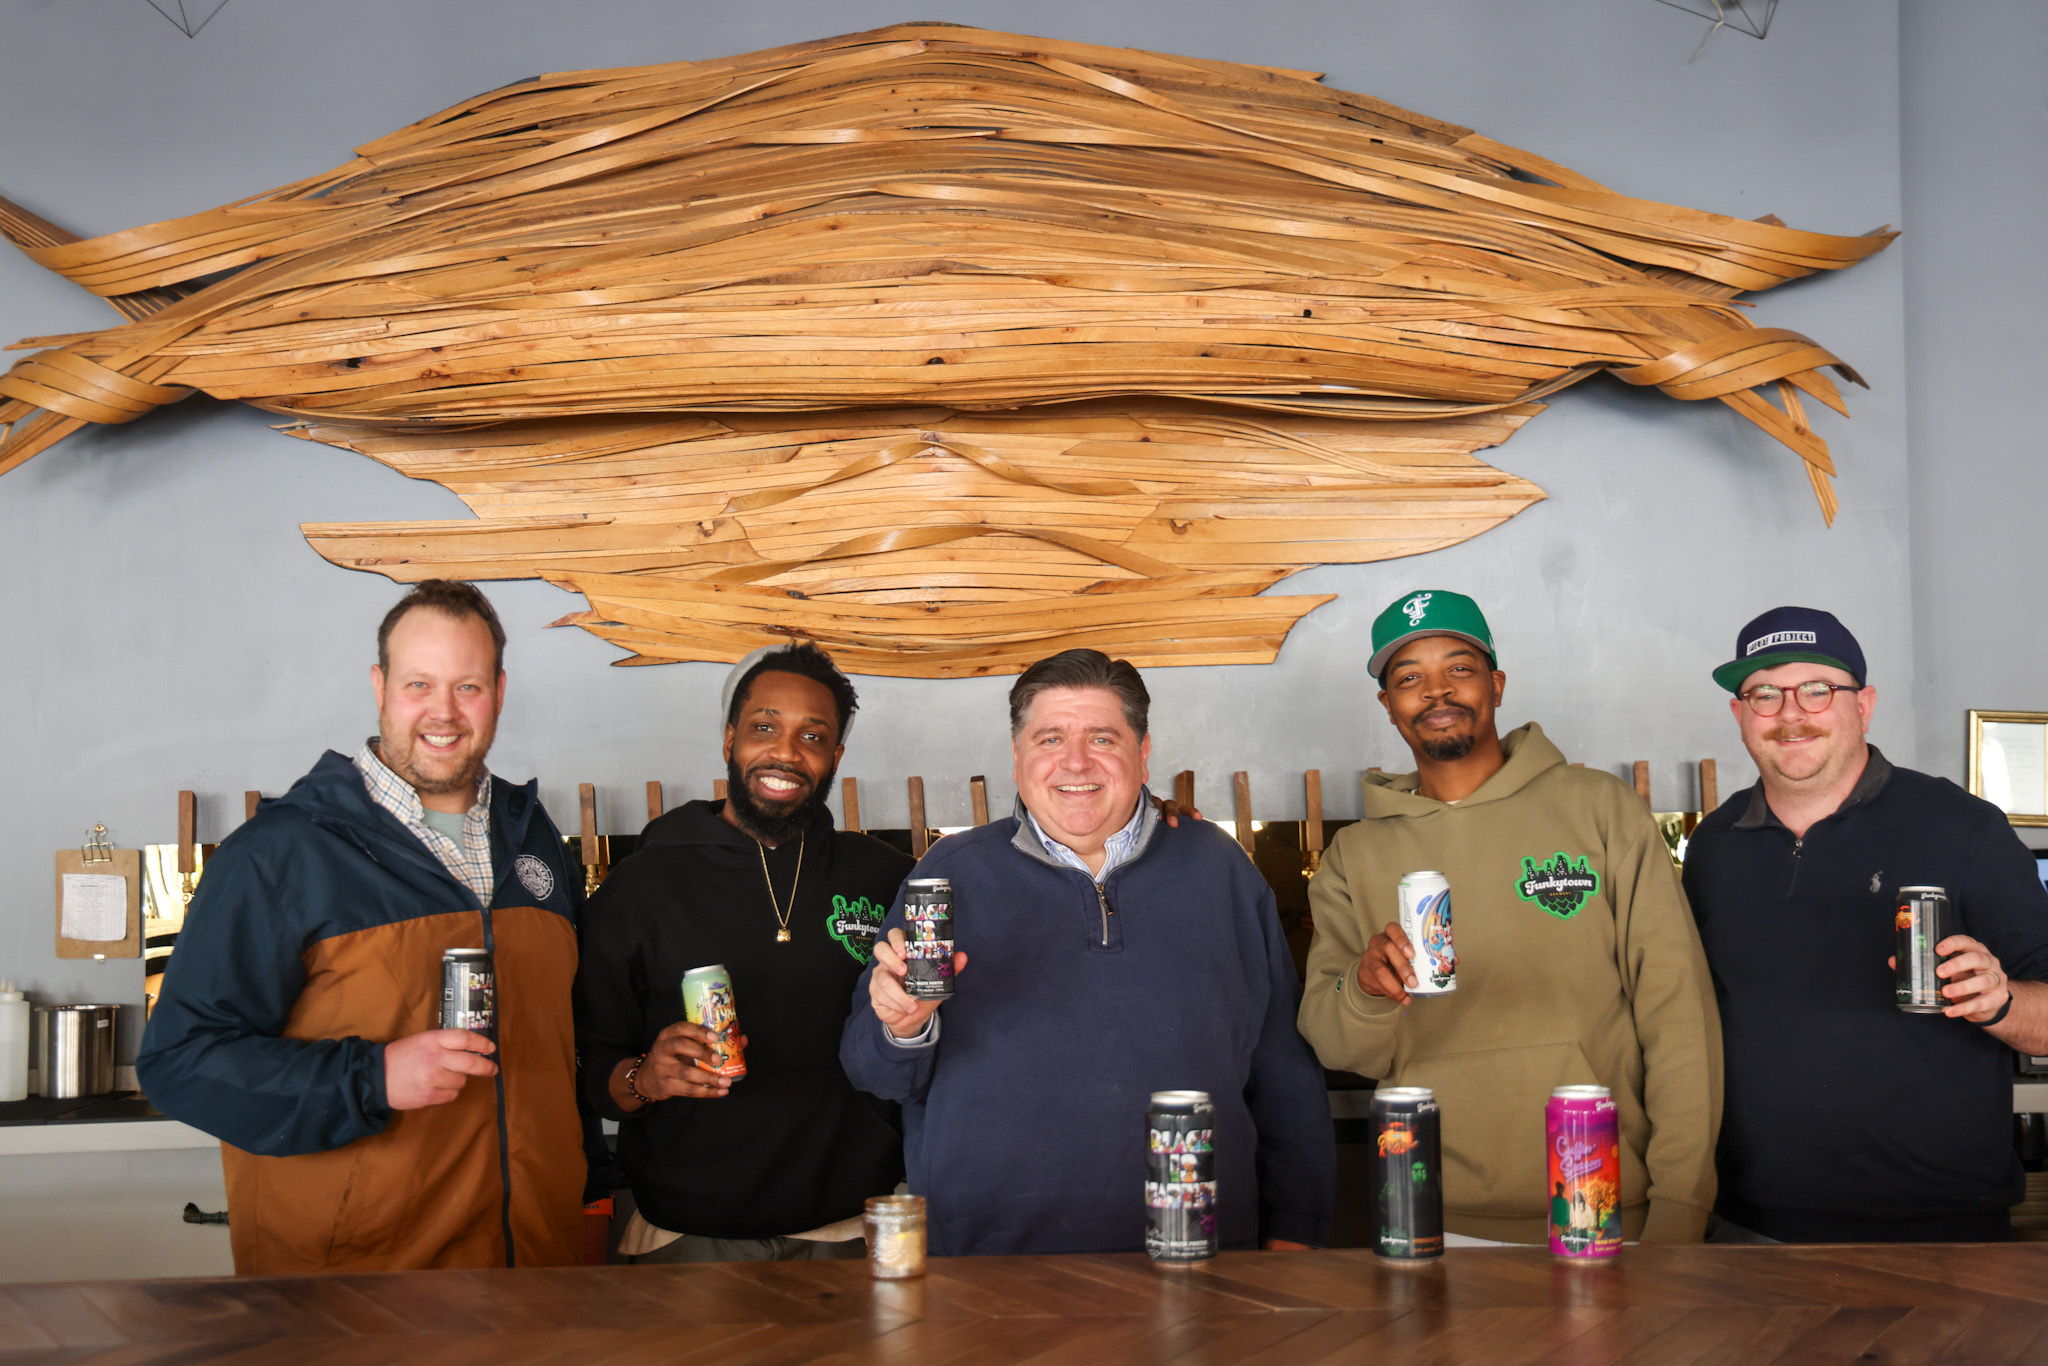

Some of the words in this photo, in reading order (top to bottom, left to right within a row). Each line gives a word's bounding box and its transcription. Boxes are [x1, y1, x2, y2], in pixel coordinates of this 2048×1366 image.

[1402, 593, 1432, 627] F
[1774, 632, 1814, 643] PROJECT
[1524, 875, 1593, 895] Funkytown
